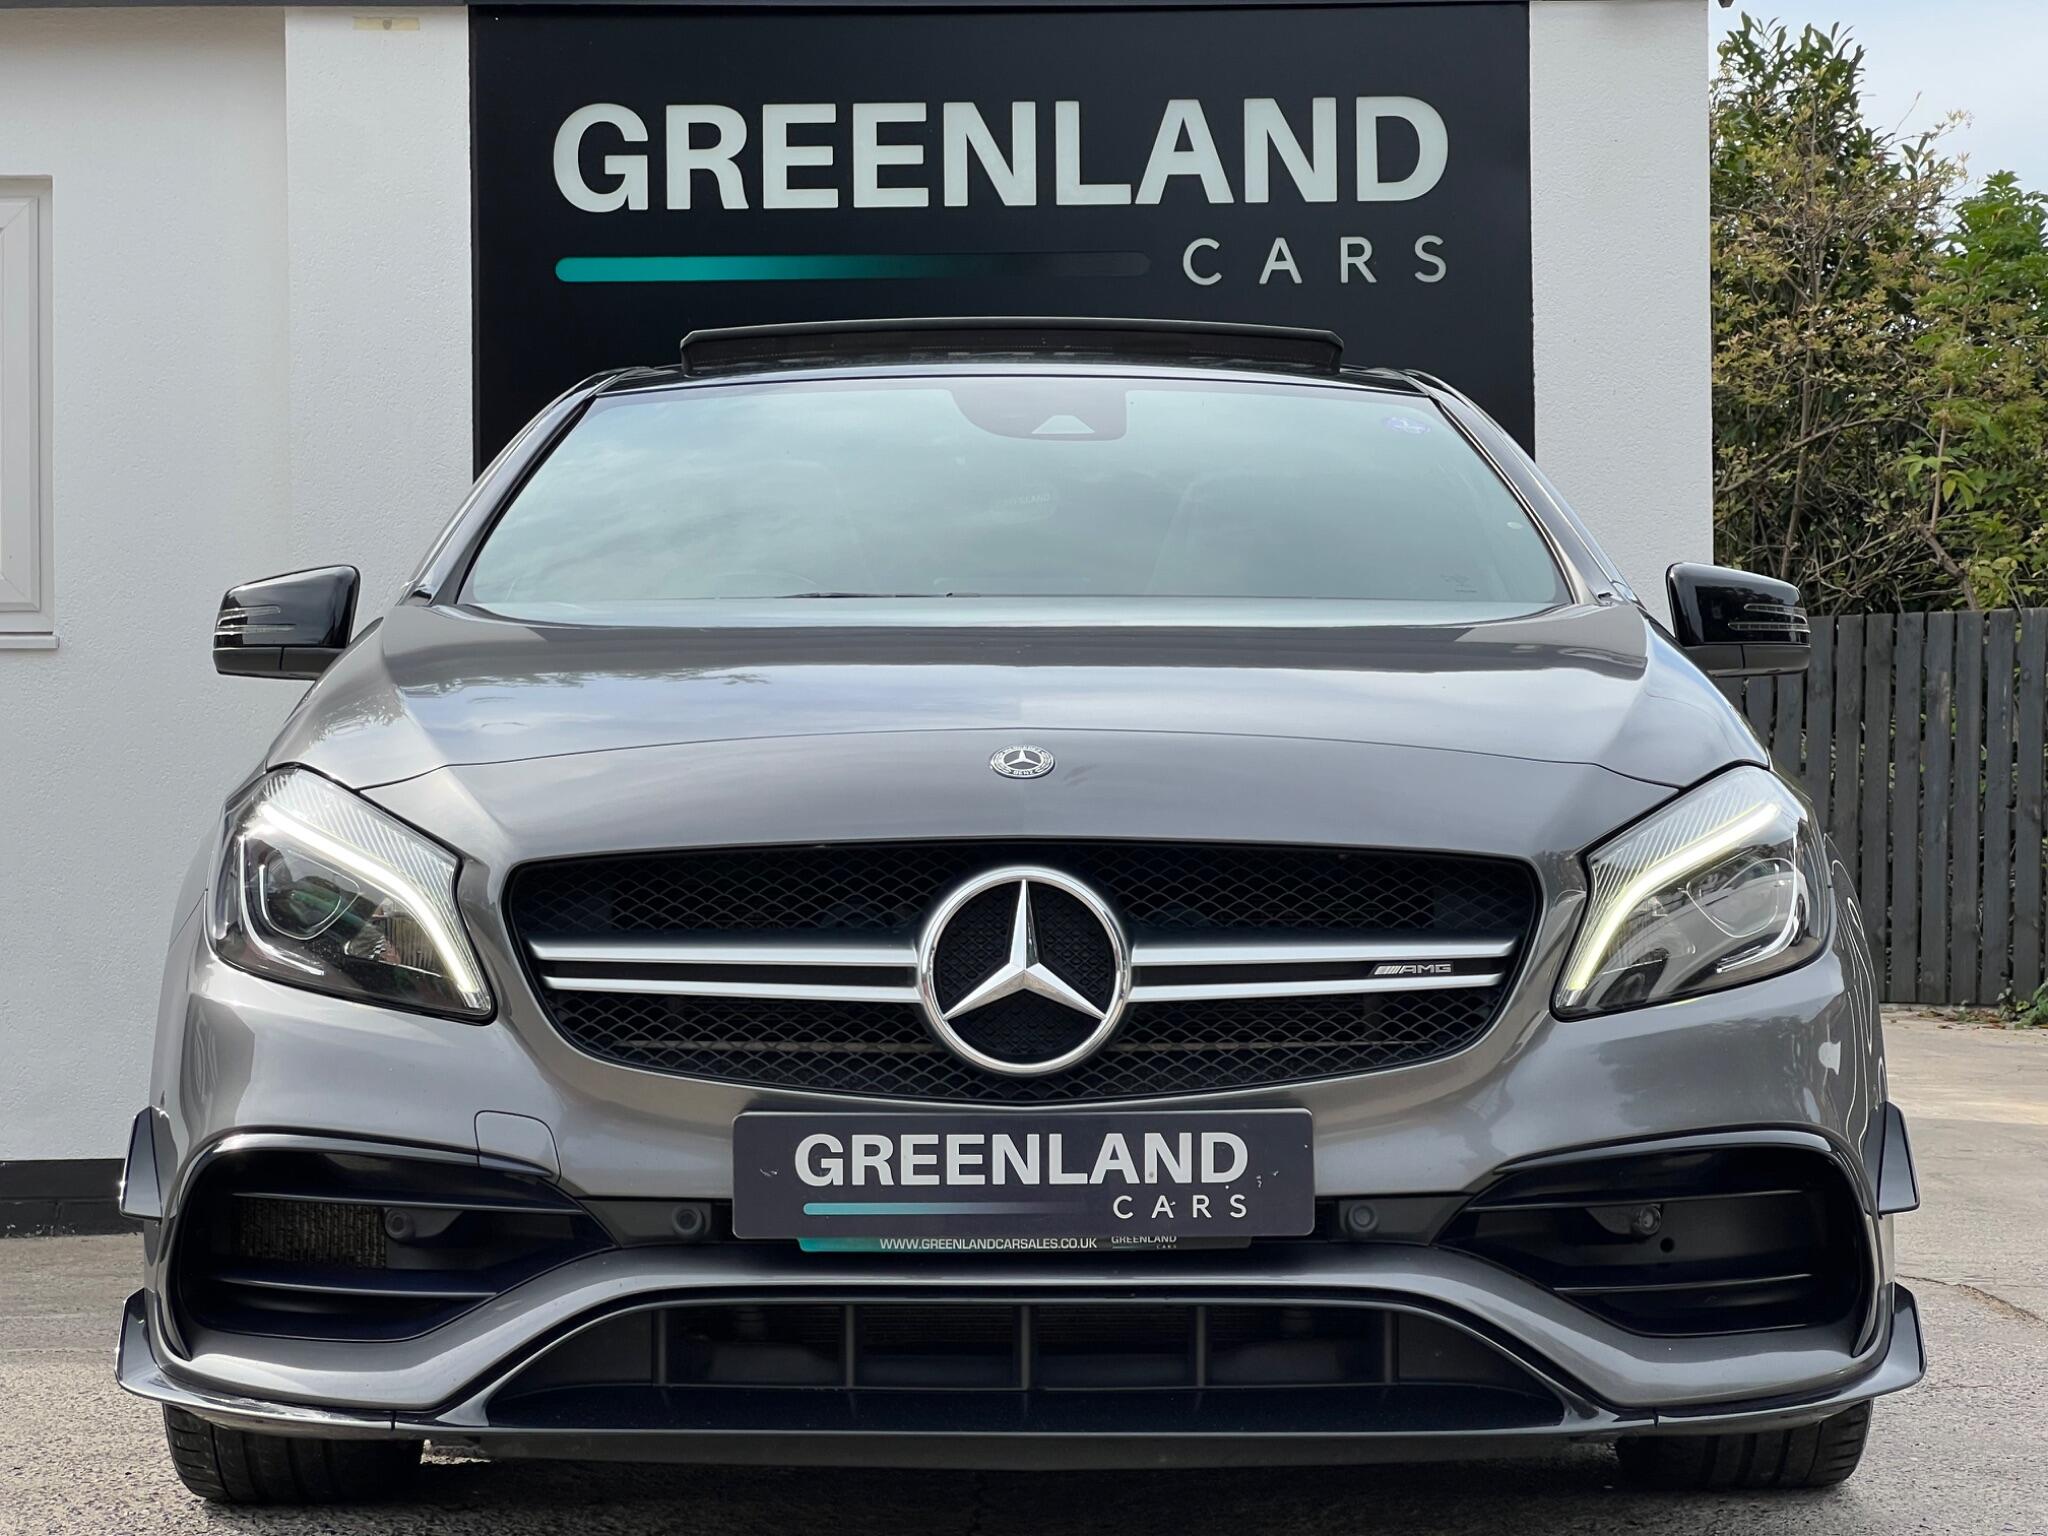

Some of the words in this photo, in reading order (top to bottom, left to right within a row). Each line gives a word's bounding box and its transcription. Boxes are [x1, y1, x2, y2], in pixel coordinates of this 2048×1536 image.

[553, 97, 1449, 213] GREENLAND
[1182, 235, 1447, 285] CARS
[795, 1132, 1248, 1187] GREENLAND
[1113, 1194, 1247, 1219] CARS
[880, 1237, 1097, 1250] WWW.GREENLANDCARSALES.CO.UK
[1111, 1235, 1177, 1244] GREENLAND
